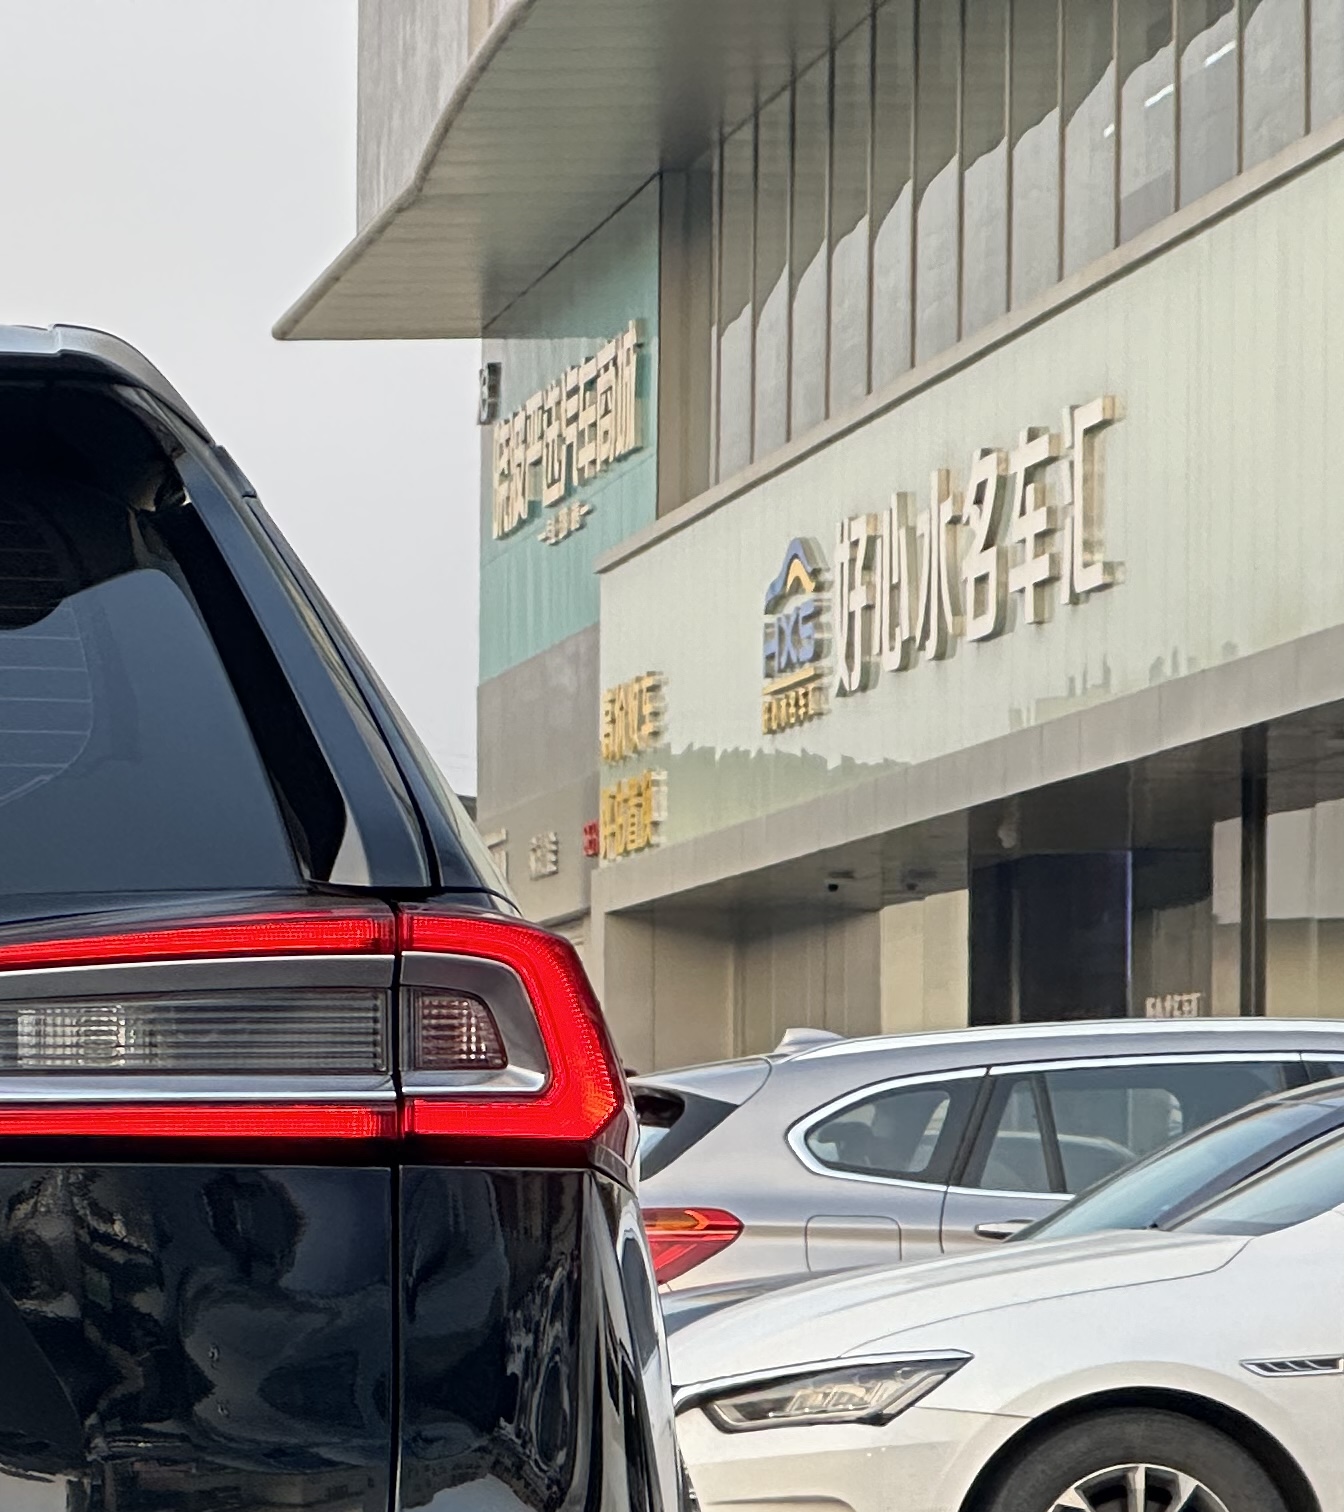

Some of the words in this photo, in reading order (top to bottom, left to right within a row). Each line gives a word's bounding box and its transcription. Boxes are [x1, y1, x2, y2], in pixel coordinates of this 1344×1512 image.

[835, 396, 1114, 697] 好心水名车汇
